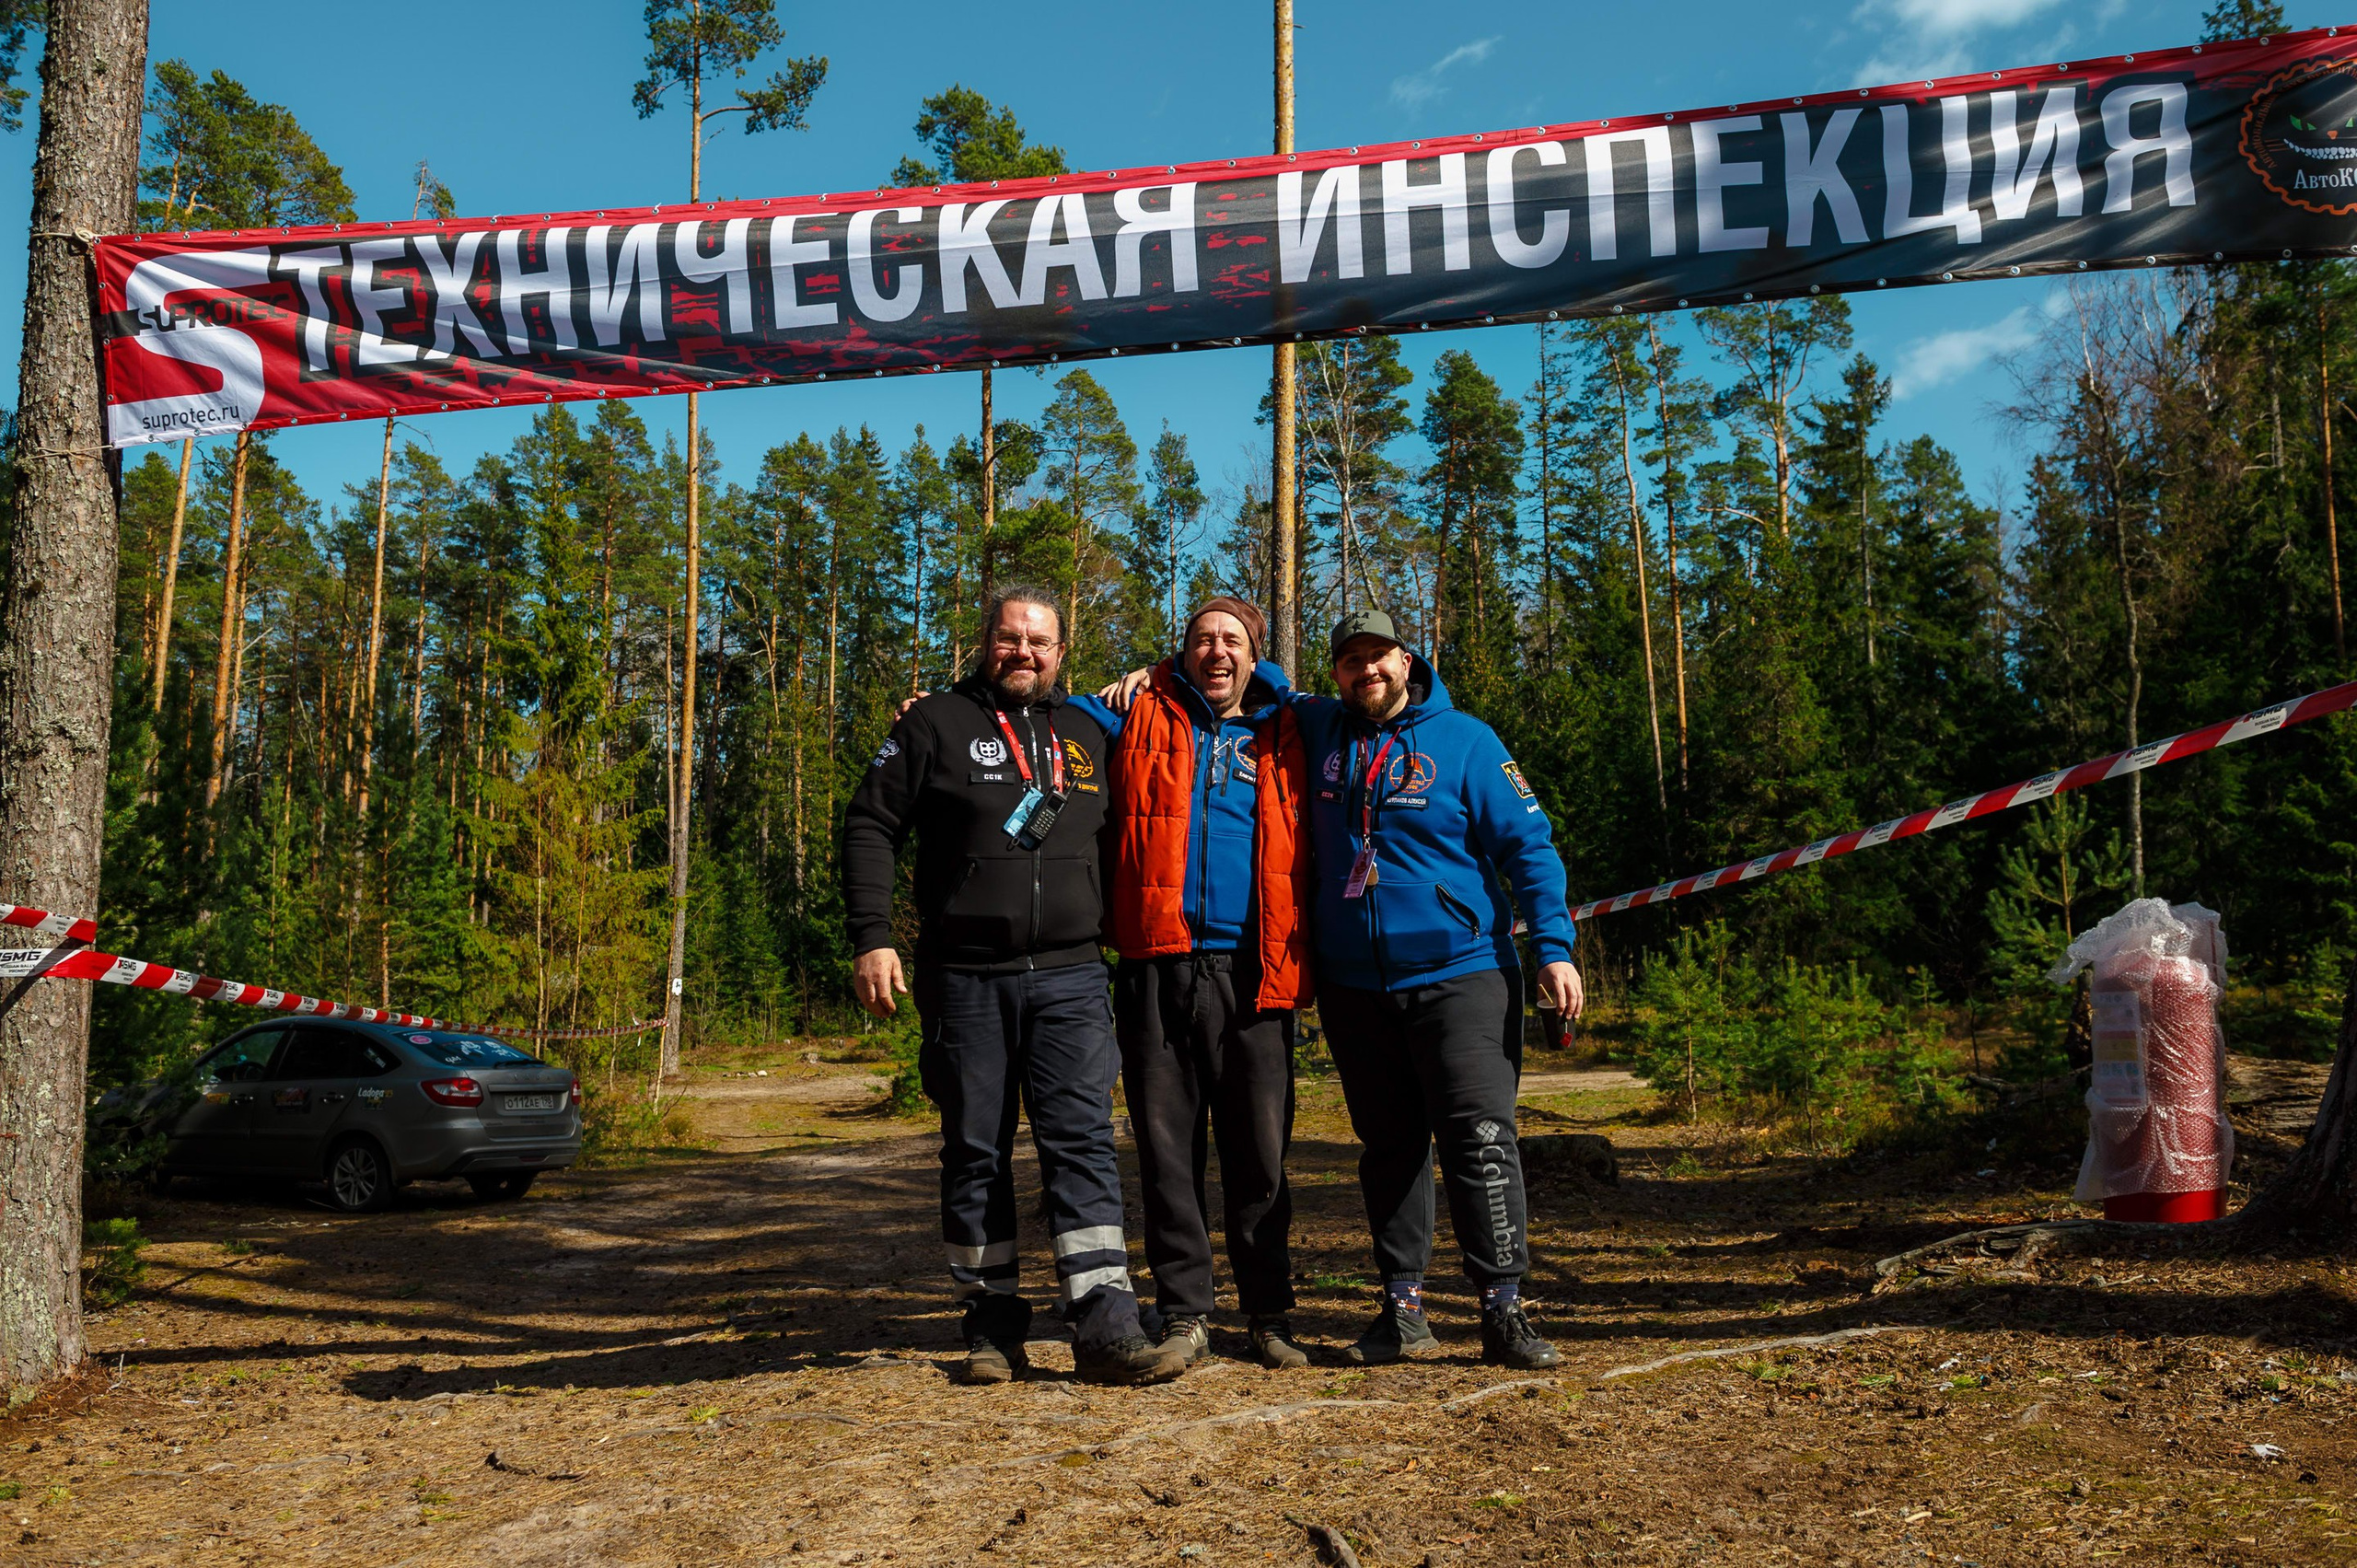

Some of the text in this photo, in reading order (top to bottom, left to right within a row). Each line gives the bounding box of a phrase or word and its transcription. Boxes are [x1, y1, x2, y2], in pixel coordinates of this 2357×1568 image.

[277, 82, 2197, 372] ТЕХНИЧЕСКАЯ ИНСПЕКЦИЯ
[142, 405, 239, 431] suprotec.ru
[1479, 1144, 1519, 1269] Columbia
